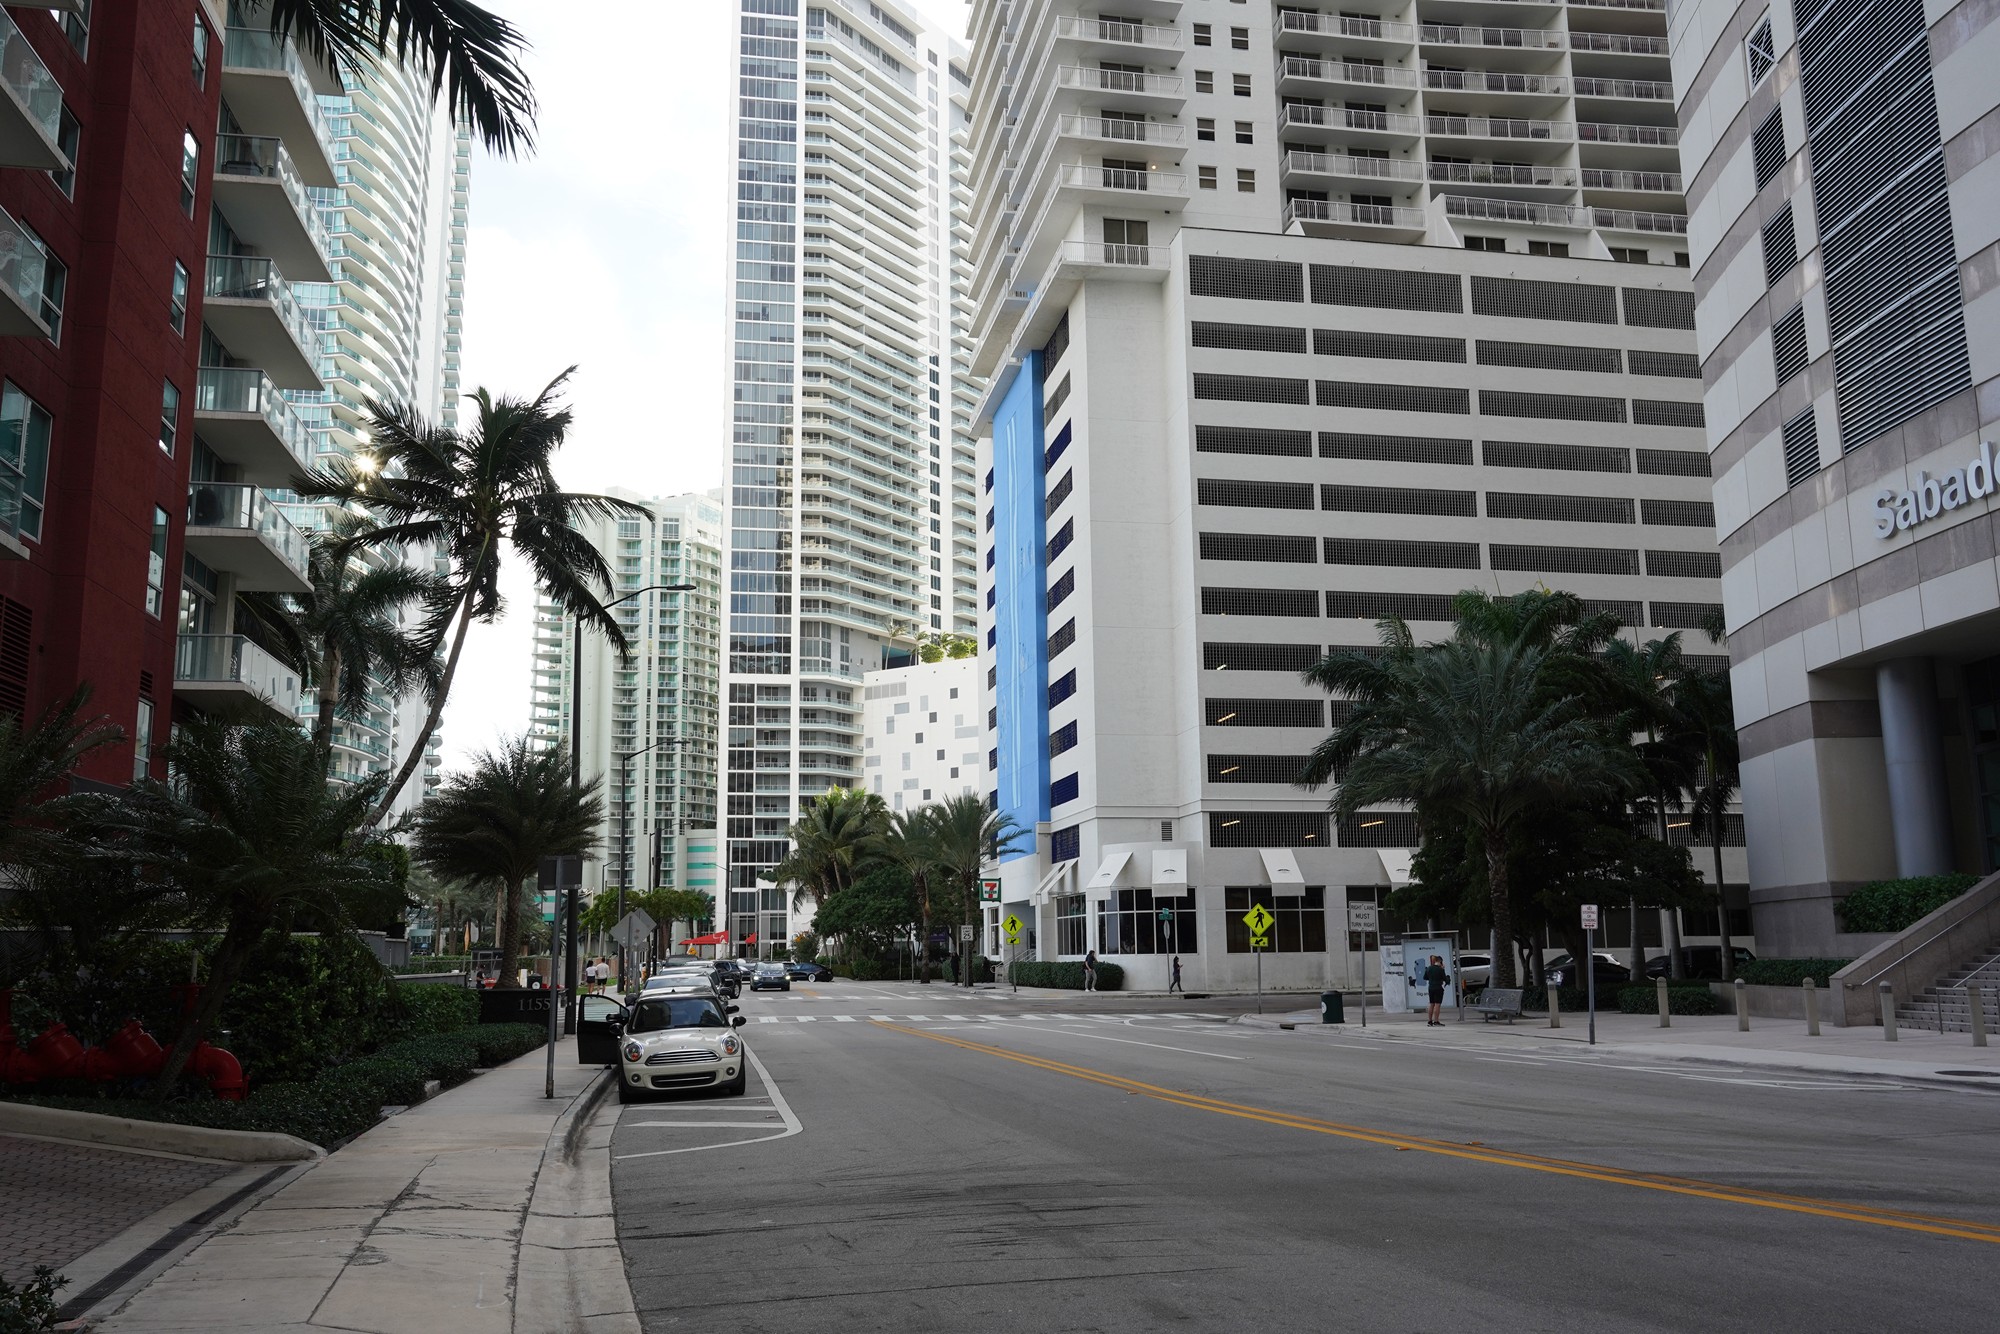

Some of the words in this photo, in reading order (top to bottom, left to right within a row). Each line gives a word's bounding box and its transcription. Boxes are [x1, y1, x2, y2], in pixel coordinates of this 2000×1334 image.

[984, 883, 997, 898] 7
[963, 932, 972, 940] 25
[519, 998, 551, 1011] 1155
